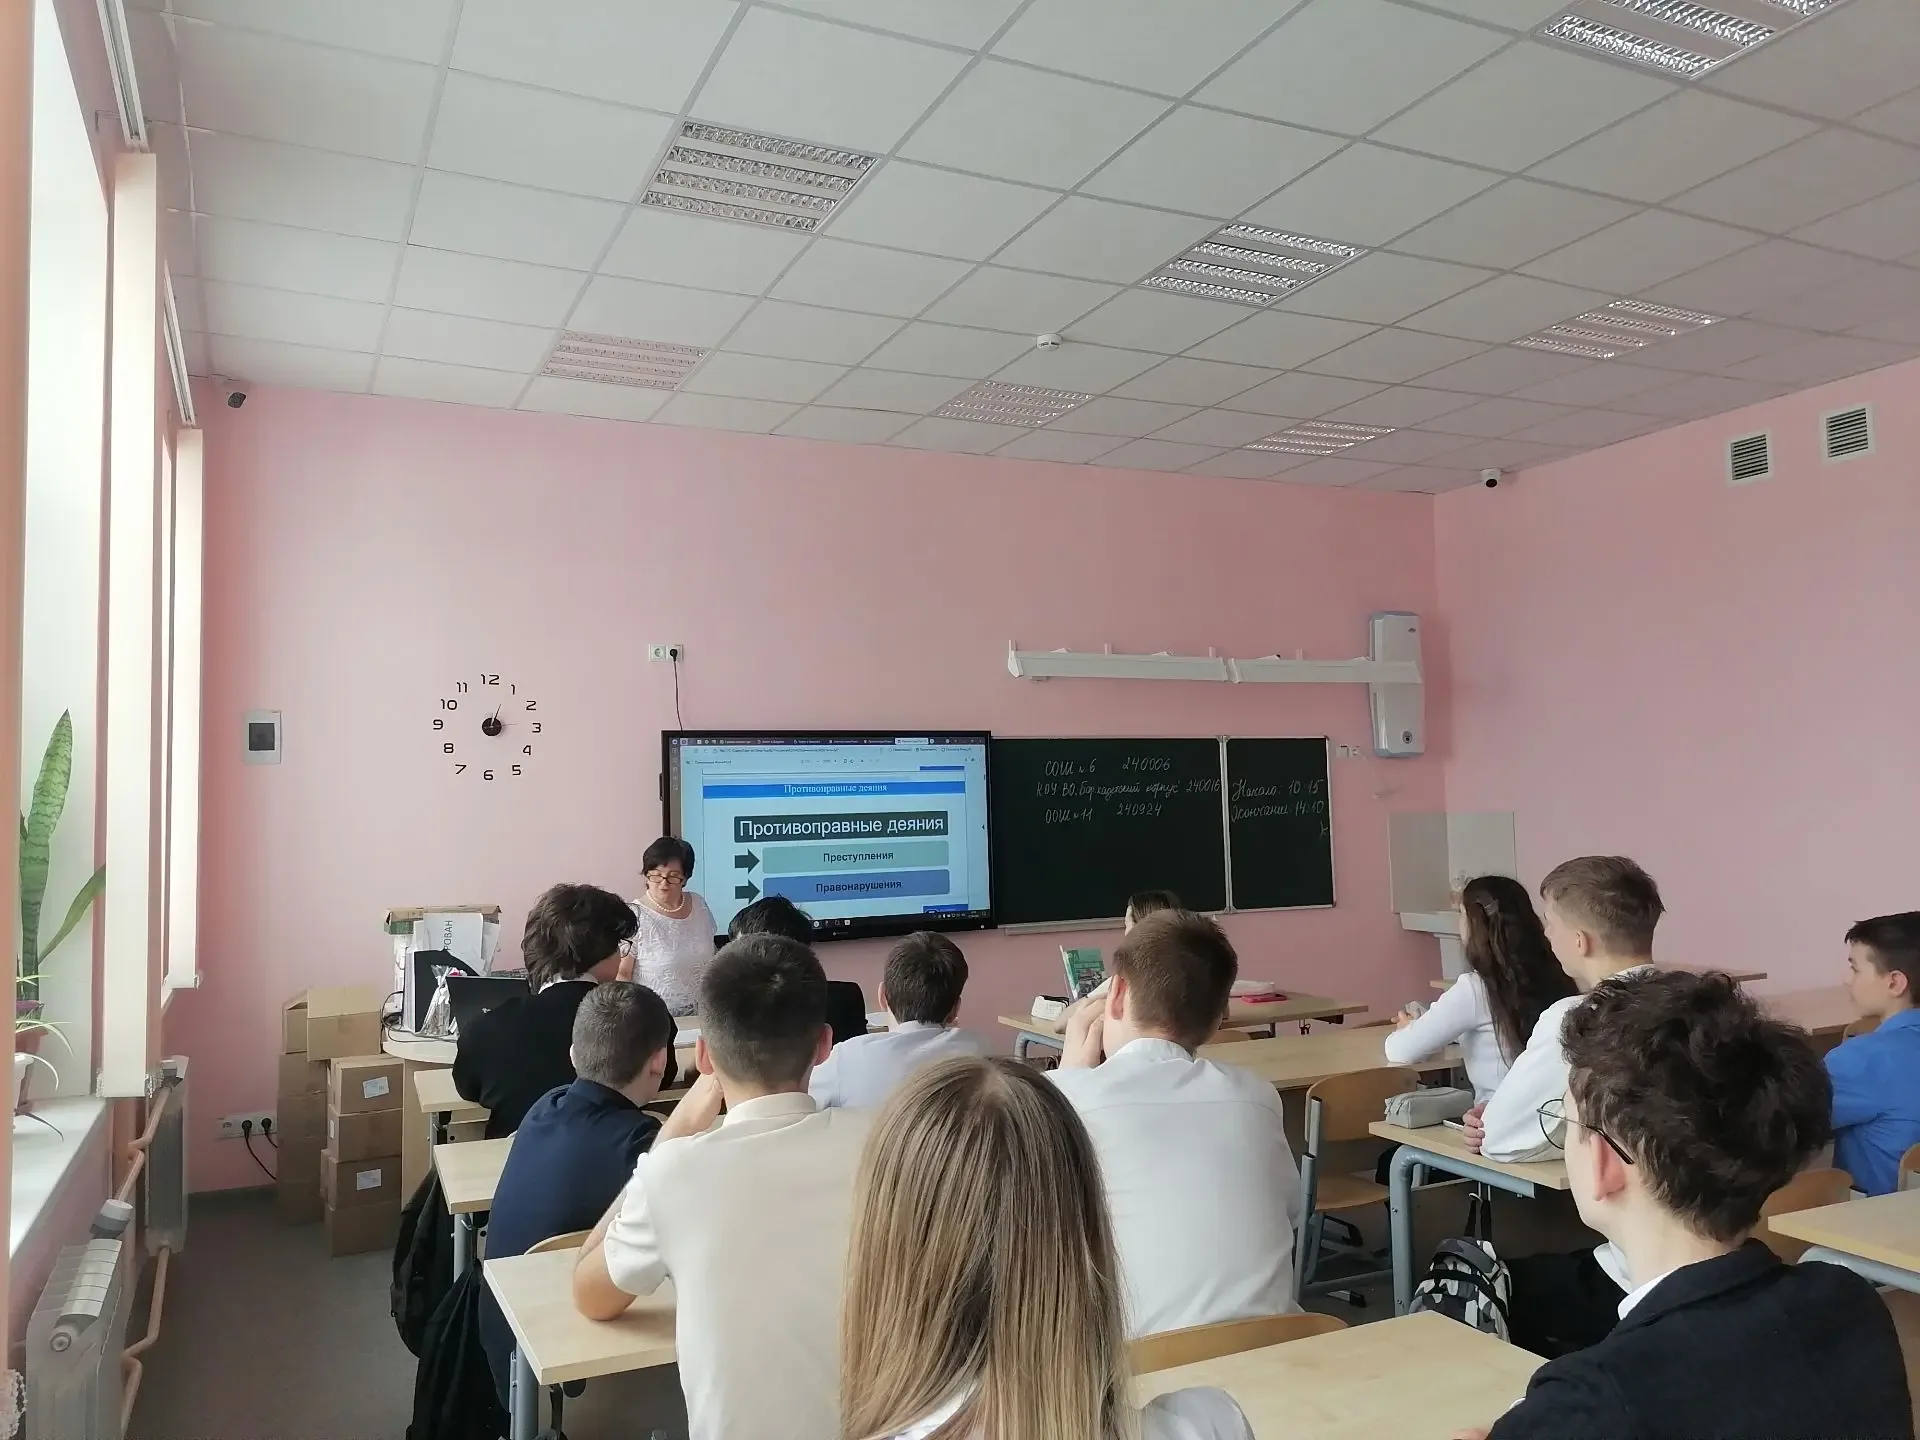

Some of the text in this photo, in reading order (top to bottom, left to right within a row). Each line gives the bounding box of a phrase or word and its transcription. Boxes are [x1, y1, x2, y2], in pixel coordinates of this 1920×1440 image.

[481, 674, 500, 685] 12
[457, 682, 468, 693] 11
[441, 698, 458, 710] 10
[526, 700, 537, 711] 2
[433, 719, 444, 730] 9
[532, 722, 542, 733] 3
[443, 743, 454, 754] 8
[522, 745, 531, 756] 4
[455, 764, 467, 775] 7
[512, 765, 522, 776] 5
[1045, 760, 1074, 776] СОШ
[1089, 758, 1097, 773] 6
[483, 770, 494, 781] 6
[783, 783, 888, 797] Противоправные деяния
[1080, 807, 1093, 822] 11
[739, 817, 944, 840] Противоправные деяния
[823, 850, 894, 863] Преступления
[816, 879, 902, 893] Правонарушения
